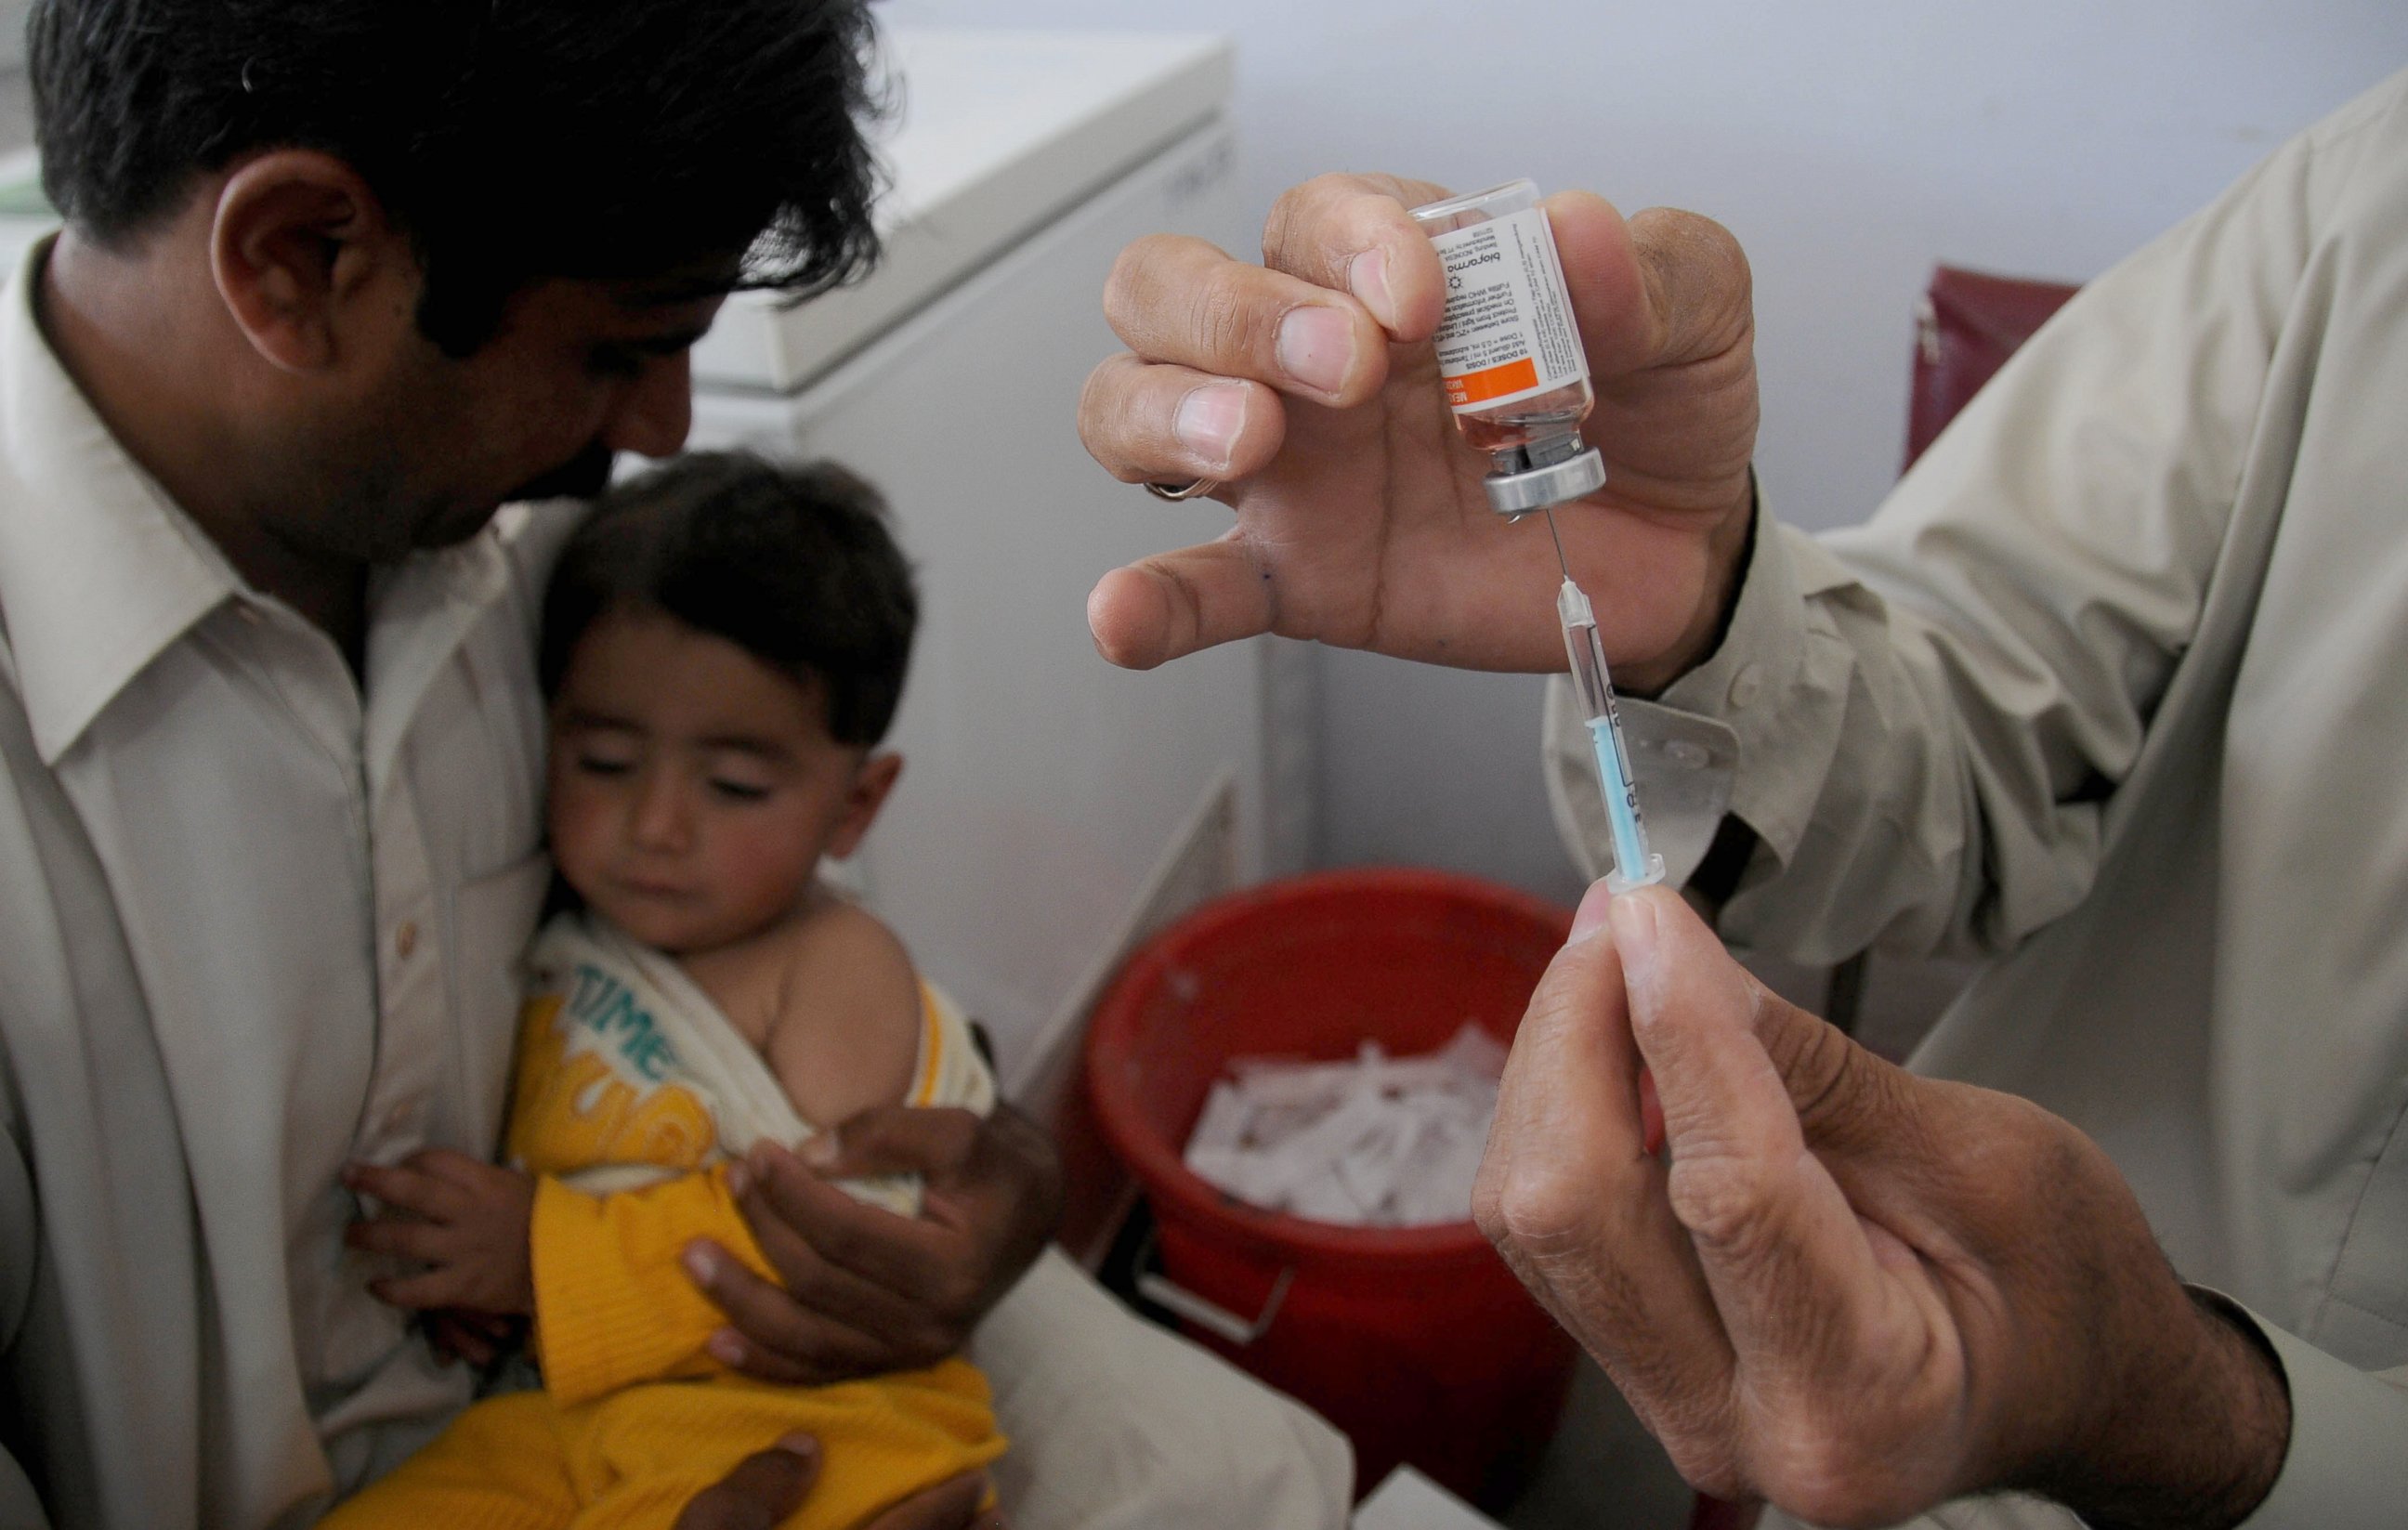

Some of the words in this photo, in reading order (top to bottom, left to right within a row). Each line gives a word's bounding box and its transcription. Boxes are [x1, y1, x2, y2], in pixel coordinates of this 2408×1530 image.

[1447, 252, 1500, 272] biofarma
[1468, 289, 1486, 298] WHO
[1451, 297, 1485, 311] information
[1476, 303, 1502, 313] medical
[1475, 314, 1491, 322] from
[1492, 307, 1516, 318] Protect
[1461, 318, 1475, 326] light
[1472, 320, 1499, 332] between
[1499, 333, 1517, 342] Dose
[1492, 350, 1518, 363] DOSES
[569, 962, 675, 1081] TIME
